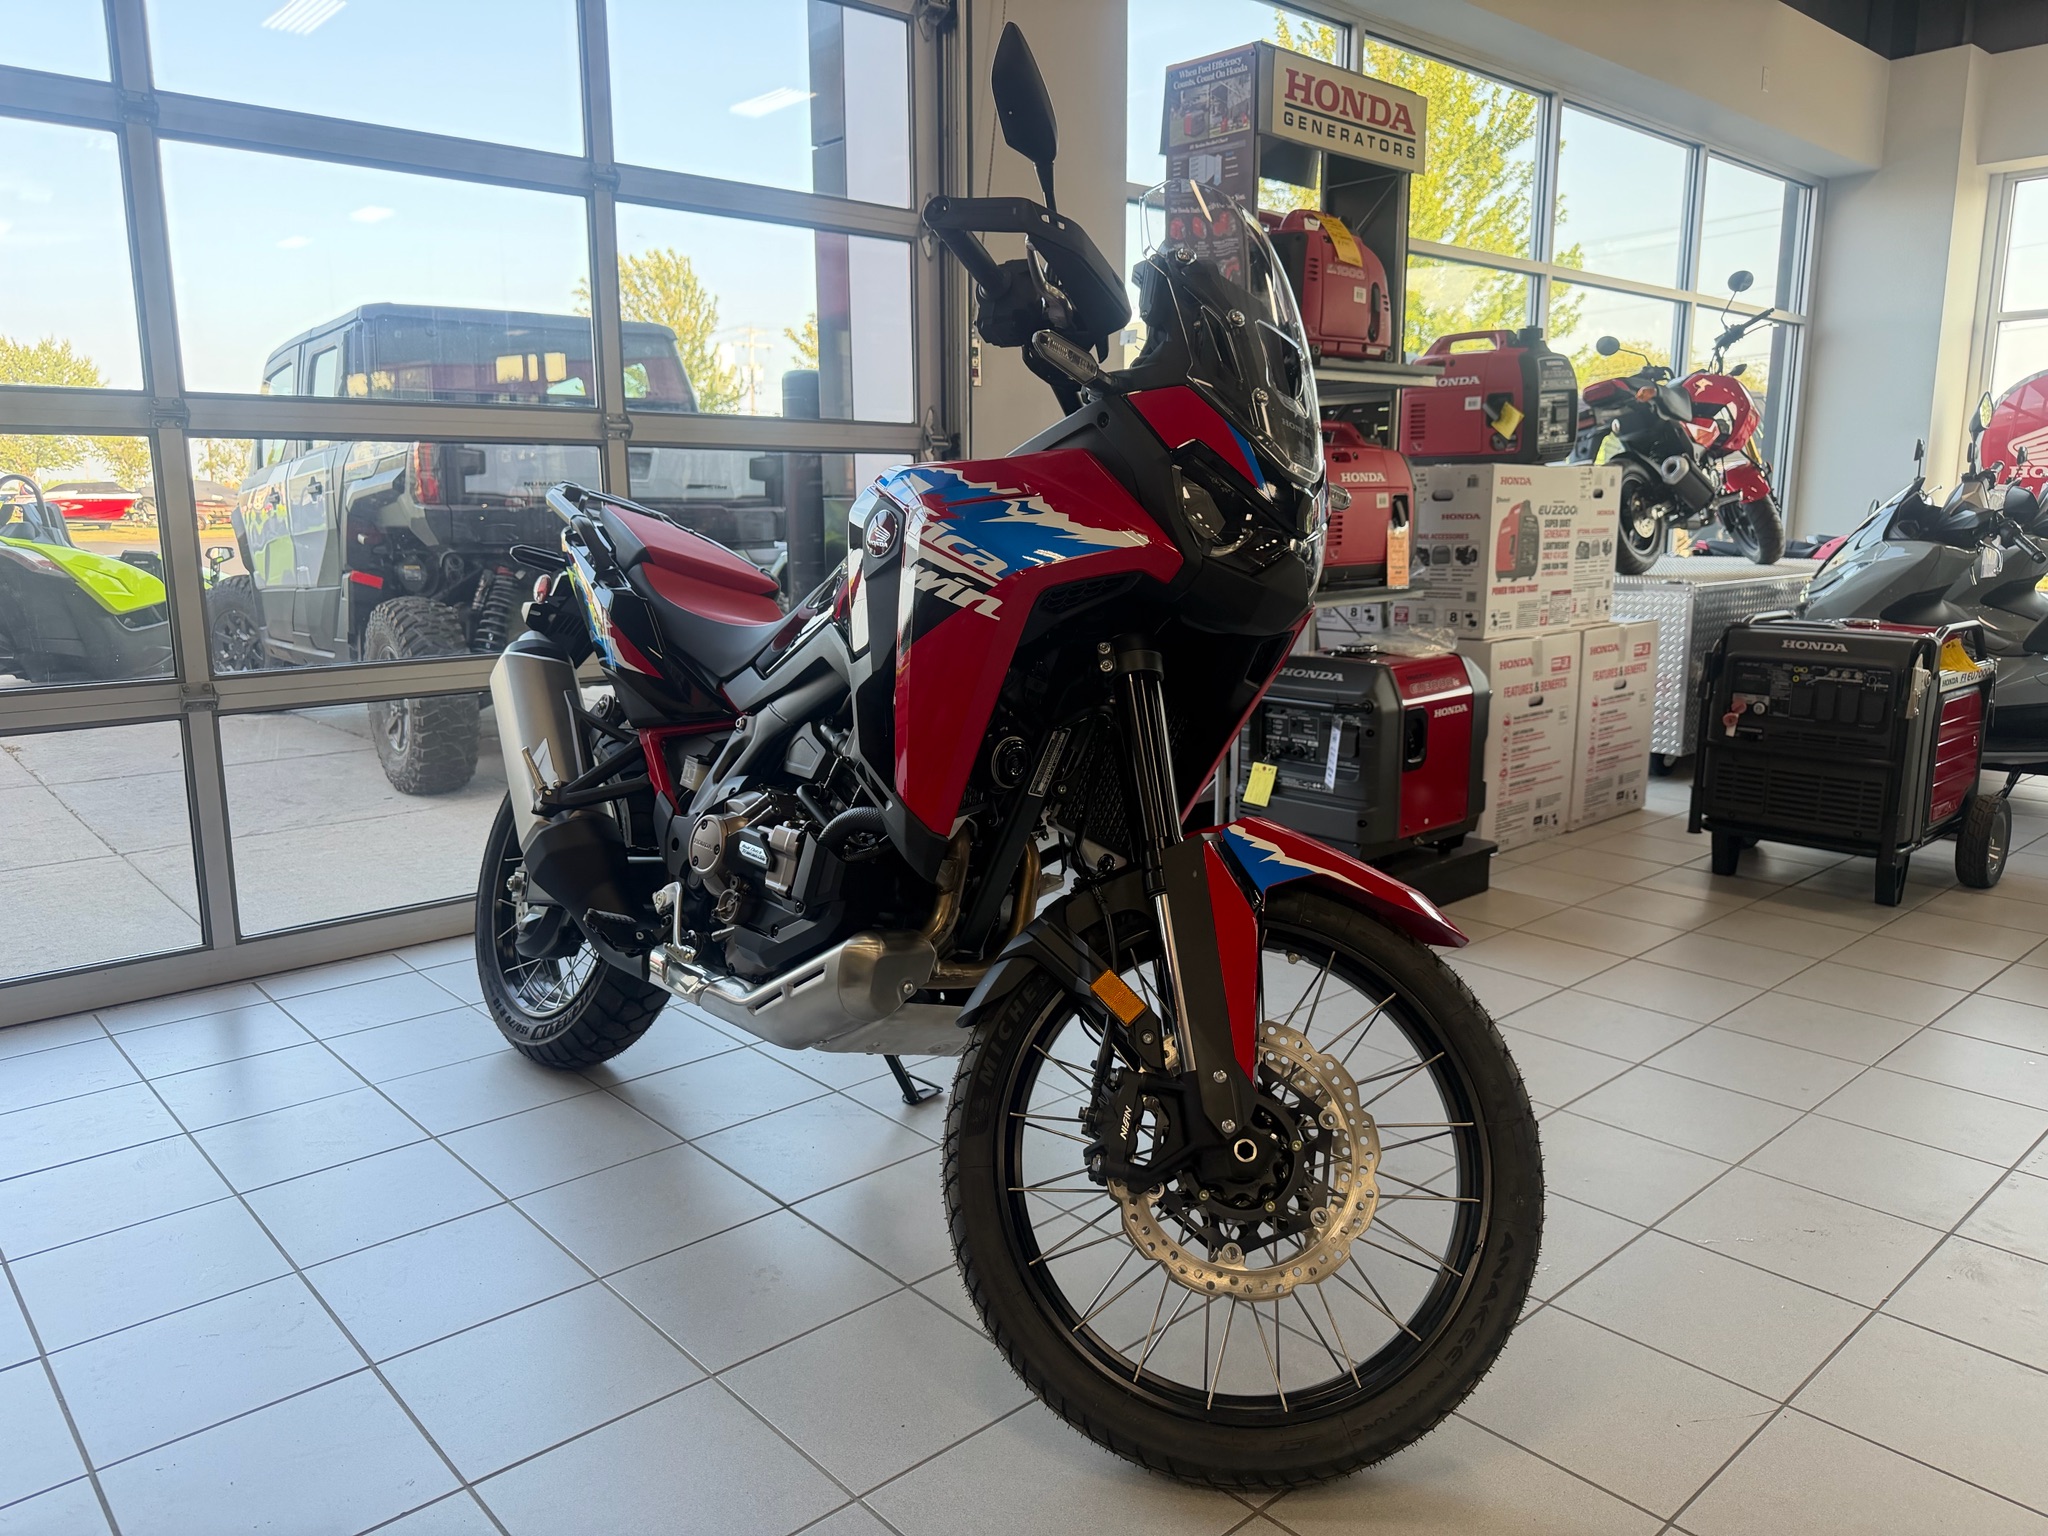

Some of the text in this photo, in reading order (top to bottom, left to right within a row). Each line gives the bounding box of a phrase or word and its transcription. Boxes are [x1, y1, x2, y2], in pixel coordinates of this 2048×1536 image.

[1179, 57, 1242, 78] When Fuel Efficiency
[1196, 74, 1215, 84] Count
[1216, 70, 1226, 79] On
[1226, 64, 1248, 76] Honda
[1285, 68, 1416, 136] HONDA
[1284, 111, 1415, 159] GENERATORS
[1436, 376, 1480, 387] ONDA
[1281, 418, 1313, 440] HONDA
[1340, 472, 1386, 482] HONDA
[1500, 476, 1532, 486] HONDA
[906, 563, 1003, 621] win
[1351, 608, 1358, 617] 8
[1450, 612, 1457, 622] 8
[1589, 644, 1620, 656] HONDA
[1781, 640, 1848, 652] HONDA
[1499, 657, 1534, 670] HONDA
[1592, 667, 1618, 682] FEATURES
[1624, 662, 1647, 676] BENEFITS
[1279, 667, 1344, 682] HONDA
[1942, 676, 1958, 687] HONDA
[1503, 677, 1568, 698] FEATURES & BENEFITS
[1434, 704, 1468, 718] HONDA
[505, 1015, 529, 1035] 150/70
[977, 981, 1038, 1086] MICHE
[1120, 1105, 1132, 1140] NISSIN
[1350, 1370, 1445, 1437] ADVENTURE
